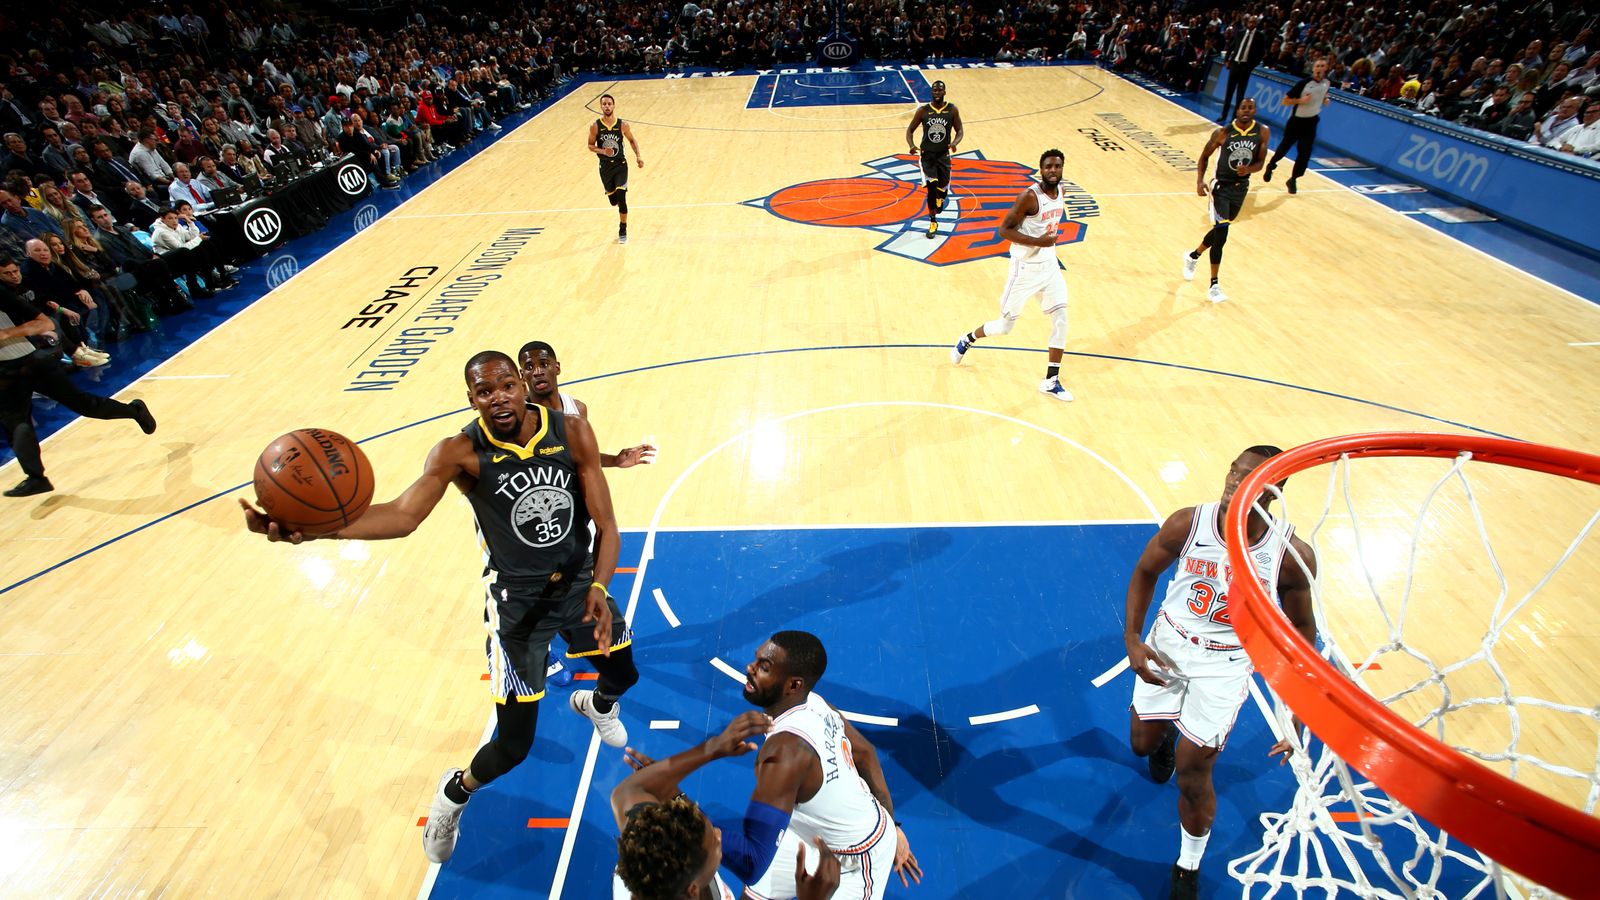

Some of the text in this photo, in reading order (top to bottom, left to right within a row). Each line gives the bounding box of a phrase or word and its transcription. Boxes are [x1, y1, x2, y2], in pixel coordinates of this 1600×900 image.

[664, 62, 1016, 79] NEW YORK KNICKS
[926, 117, 948, 127] TOWN
[600, 133, 620, 142] TOWN
[1077, 127, 1125, 151] CHASE
[1227, 140, 1257, 152] TOWN
[1397, 134, 1489, 192] zoom
[341, 169, 364, 191] KIA
[247, 213, 278, 240] KIA
[341, 266, 439, 329] CHASE
[343, 227, 545, 391] MADISON SQUARE GARDEN
[539, 445, 565, 455] Rakuten
[495, 466, 571, 500] TOWN
[498, 472, 510, 484] The
[535, 517, 562, 542] 35
[1185, 558, 1218, 580] NEW
[1187, 580, 1233, 627] 32
